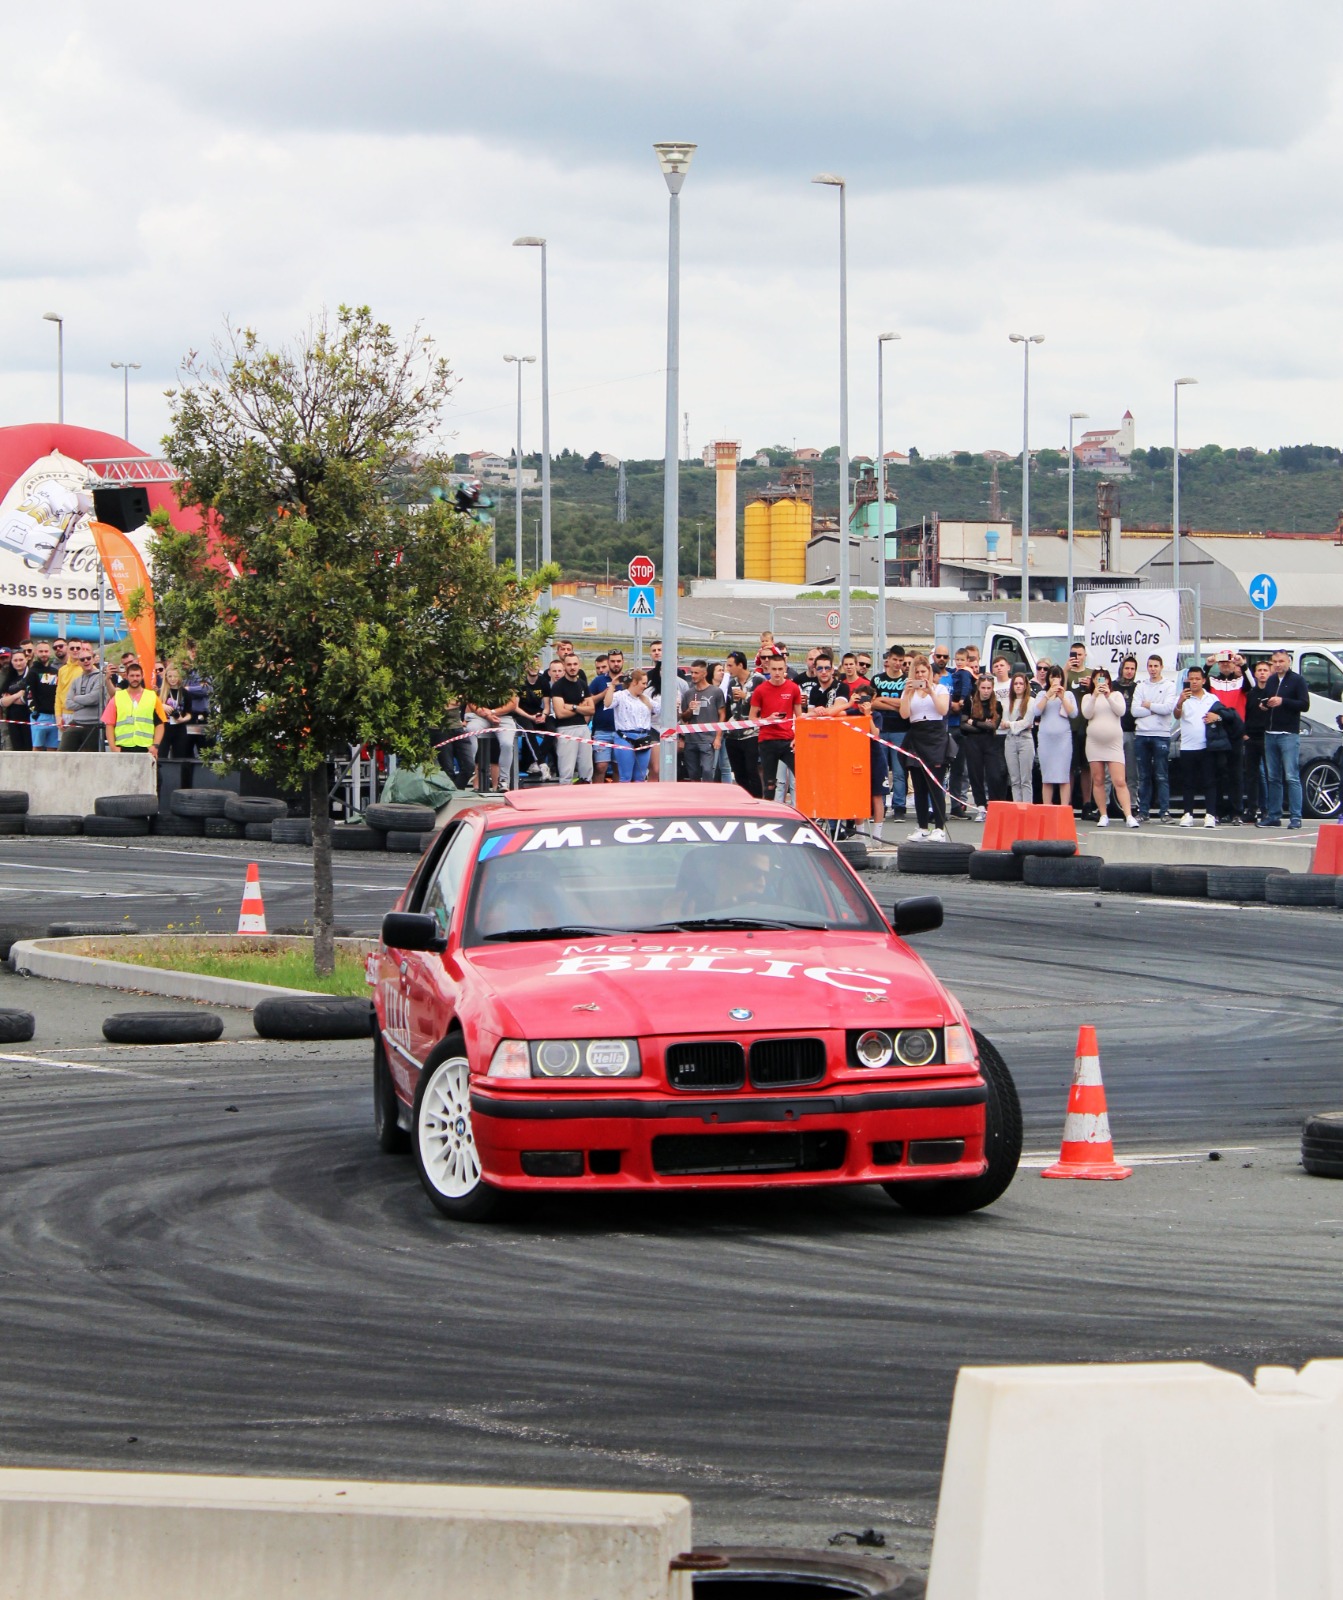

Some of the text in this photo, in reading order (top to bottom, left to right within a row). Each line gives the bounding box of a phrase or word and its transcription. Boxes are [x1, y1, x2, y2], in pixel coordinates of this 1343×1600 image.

[631, 565, 653, 578] STOP
[0, 583, 38, 598] +385
[42, 587, 63, 600] 95
[67, 588, 99, 600] 506
[830, 615, 839, 625] 80
[1090, 630, 1160, 646] Exclusive Cars
[521, 818, 830, 852] M. ČAVKA
[562, 944, 774, 956] Mesnice
[592, 1053, 624, 1064] Hella
